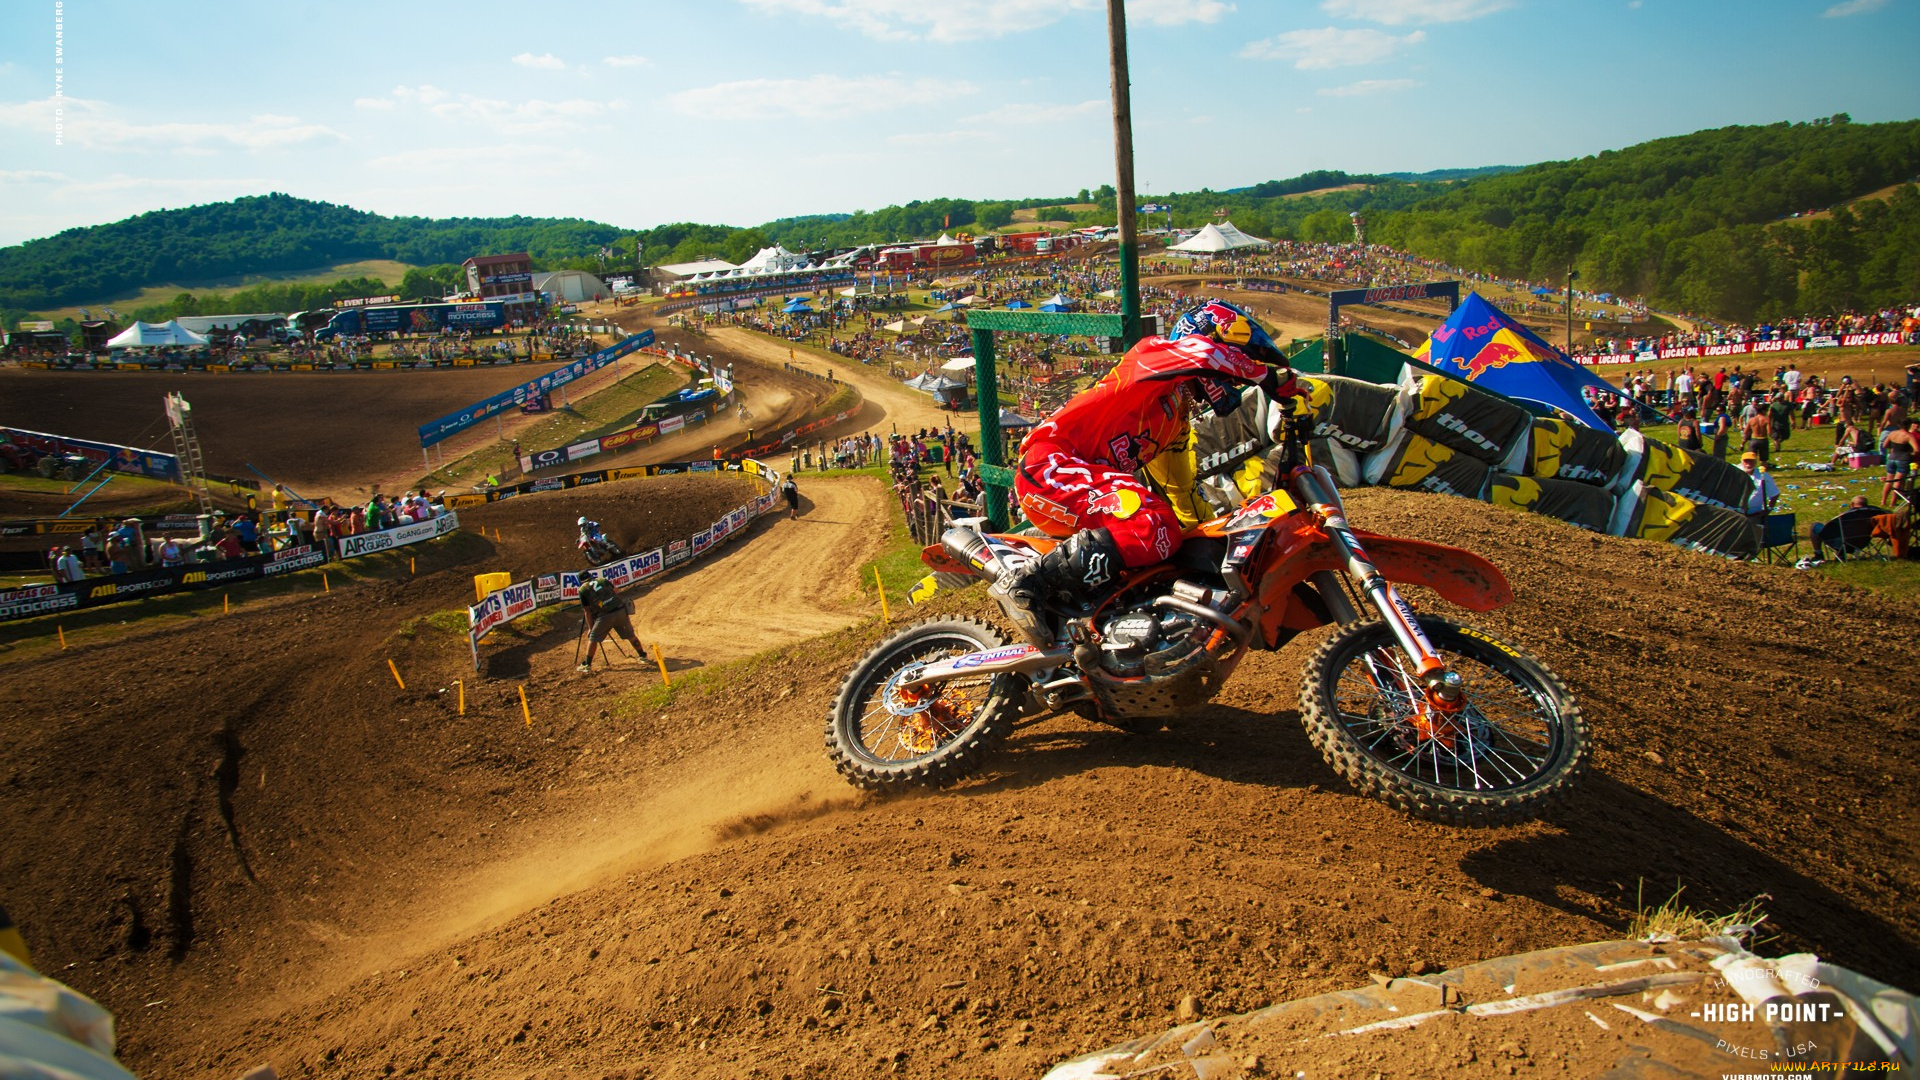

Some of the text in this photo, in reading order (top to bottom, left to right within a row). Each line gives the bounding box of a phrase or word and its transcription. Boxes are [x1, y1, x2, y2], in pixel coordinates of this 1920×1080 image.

[343, 295, 392, 307] EVENT T-SHIRTS
[1364, 284, 1428, 304] LUCAS OIL
[447, 312, 497, 320] MOTOCROSS
[1331, 321, 1339, 339] LUCA
[1462, 315, 1502, 341] Red
[1753, 341, 1782, 351] LUCAS
[1783, 339, 1800, 350] OIL
[1844, 334, 1879, 346] LUCAS
[1880, 332, 1899, 344] OIL
[1660, 348, 1685, 359] LUCAS
[1686, 346, 1699, 357] OIL
[1704, 341, 1747, 356] LUCAS OIL
[1581, 355, 1594, 365] OIL
[1598, 355, 1619, 364] LUCAS
[1620, 354, 1632, 363] OIL
[1313, 422, 1378, 449] thor
[1436, 412, 1500, 452] thor
[1200, 437, 1258, 471] thor
[534, 457, 566, 469] OAKLEY
[580, 476, 601, 484] thor
[620, 471, 640, 479] thor
[1022, 492, 1079, 528] KTM
[1, 526, 29, 535] hor
[365, 532, 391, 541] NATIONAL
[396, 526, 434, 540] GoANG.com
[276, 545, 311, 559] LUCAS OIL
[344, 537, 393, 556] AIR GUARD
[263, 553, 325, 575] MOTOCROSS
[630, 552, 660, 571] PARTS
[602, 563, 627, 580] PARTS
[631, 563, 661, 579] UNLIMITED
[589, 579, 603, 592] 2
[4, 586, 56, 601] LUCAS OIL
[503, 584, 532, 606] PARTS
[0, 596, 78, 617] OTOCROSS
[1458, 627, 1522, 658] DUNLOP
